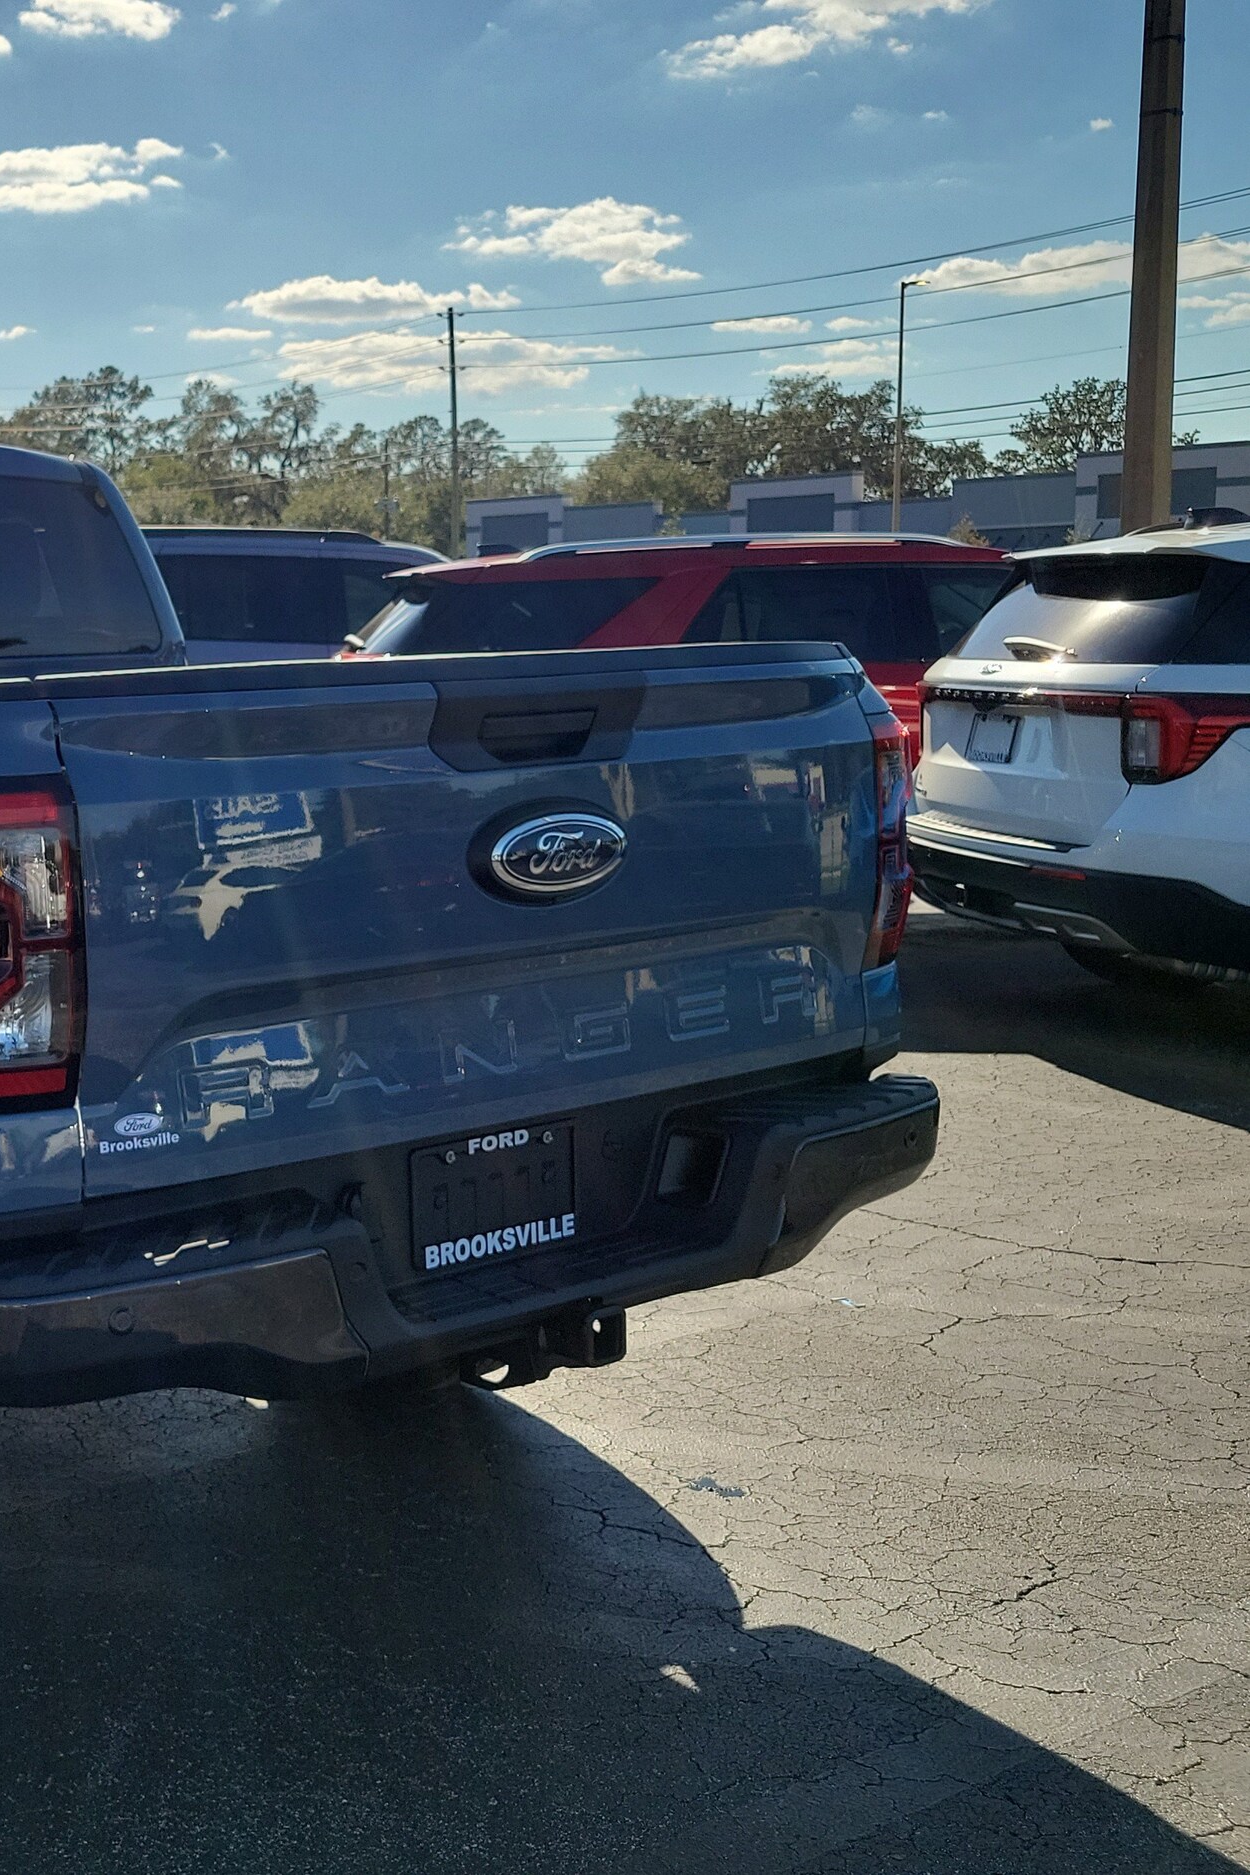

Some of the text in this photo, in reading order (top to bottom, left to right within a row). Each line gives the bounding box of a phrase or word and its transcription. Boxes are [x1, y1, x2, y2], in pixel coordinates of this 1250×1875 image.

[529, 831, 601, 875] Ford
[177, 975, 818, 1129] RANGER
[123, 1117, 153, 1132] Ford
[468, 1129, 529, 1155] FORD
[99, 1132, 180, 1154] Brooksville
[425, 1213, 575, 1270] BROOKSVILLE
